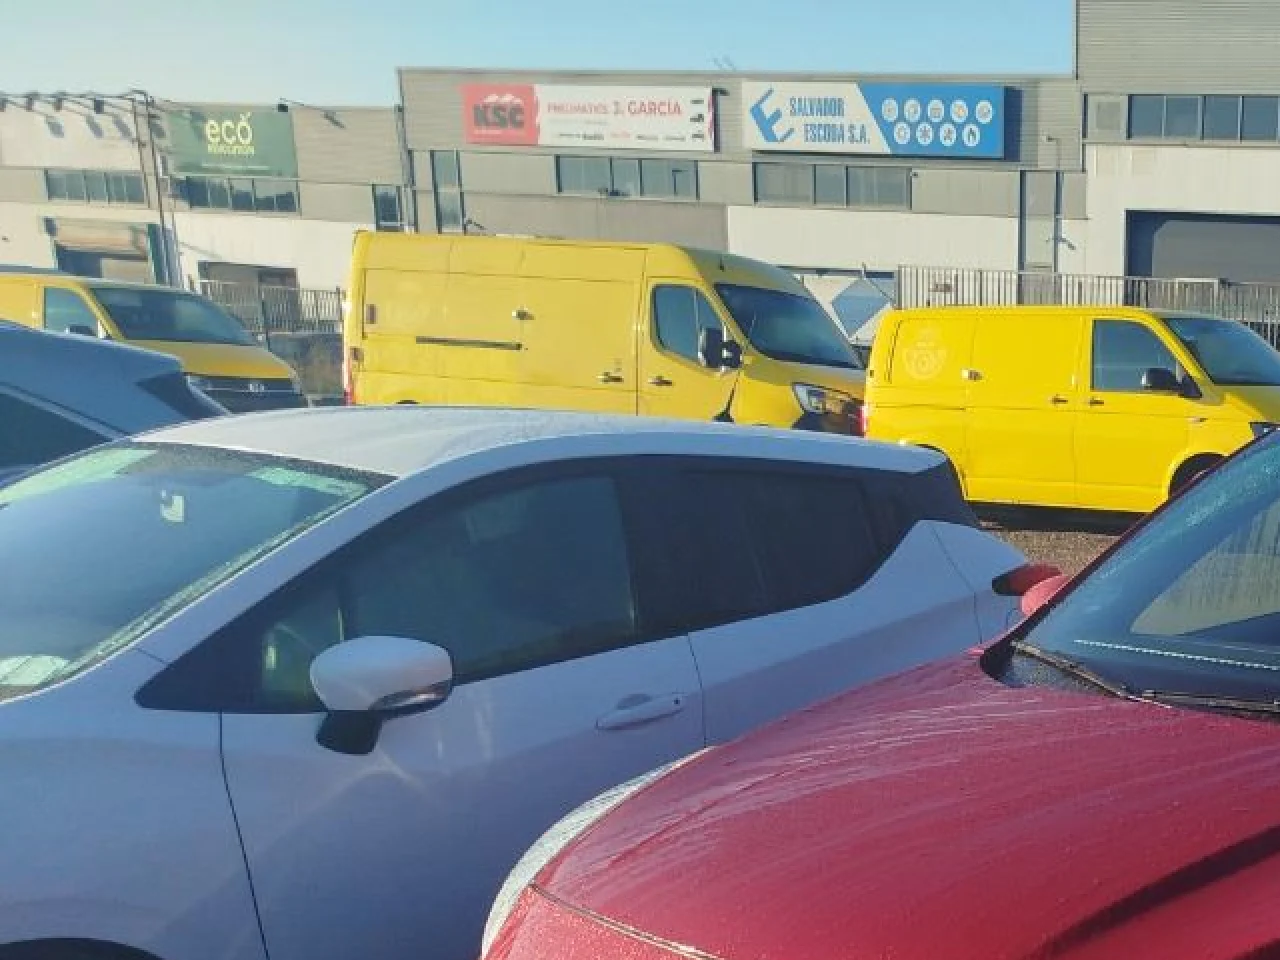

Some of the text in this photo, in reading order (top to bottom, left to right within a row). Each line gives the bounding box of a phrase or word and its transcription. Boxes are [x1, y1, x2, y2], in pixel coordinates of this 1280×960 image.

[472, 102, 525, 129] KSC
[789, 97, 845, 116] SALVADOR
[804, 123, 871, 144] ESCODA S.A.
